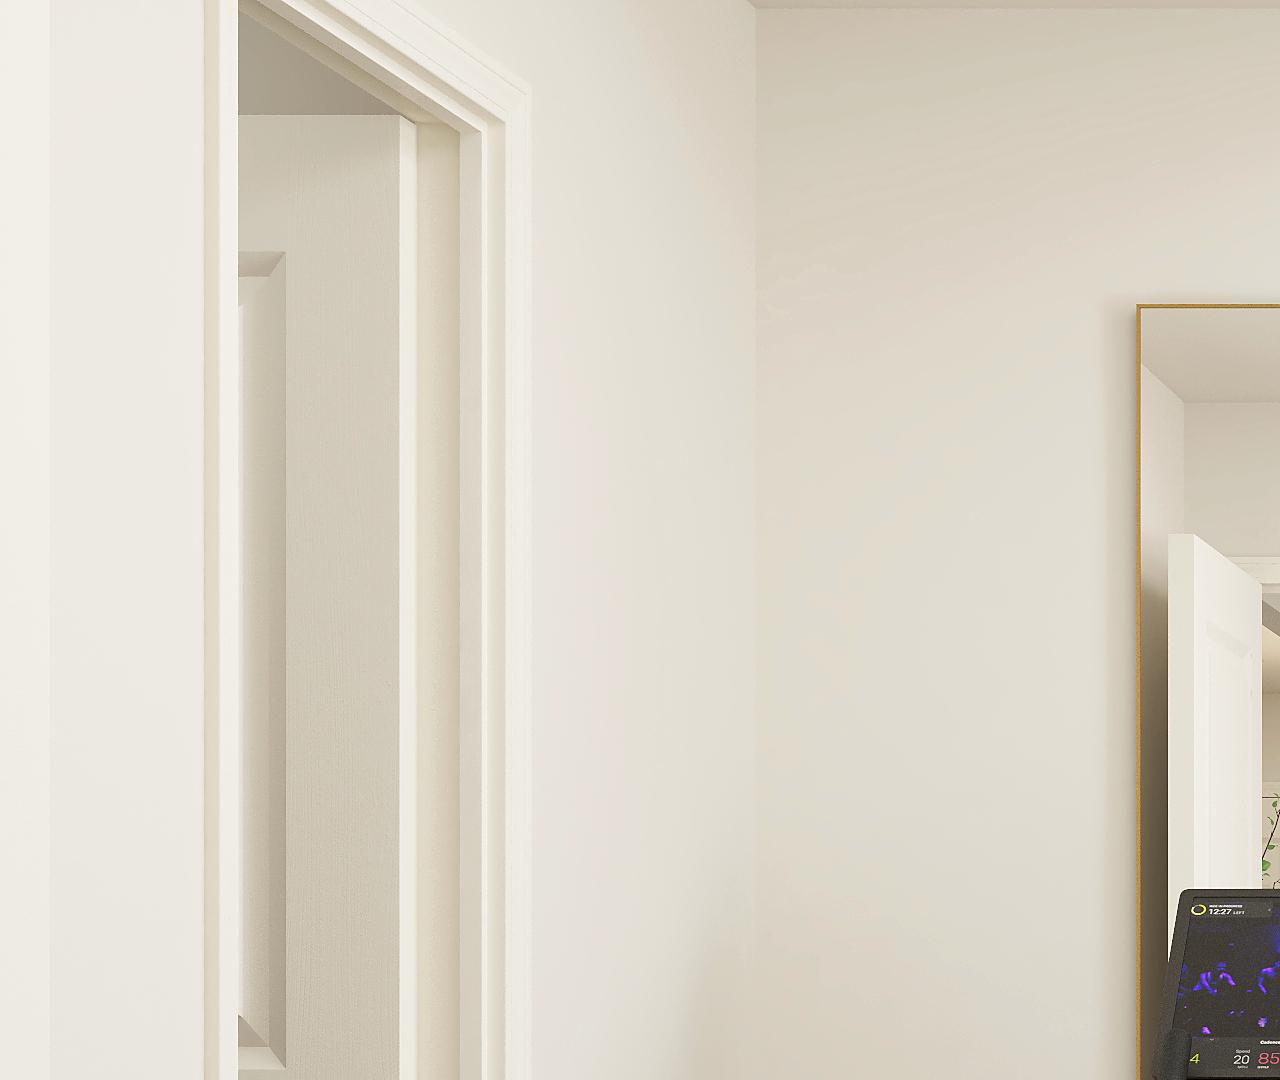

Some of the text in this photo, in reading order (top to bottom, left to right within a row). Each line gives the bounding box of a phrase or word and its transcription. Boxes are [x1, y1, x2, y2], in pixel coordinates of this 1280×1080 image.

[1189, 1053, 1200, 1064] 4
[1233, 1055, 1250, 1064] 20
[1258, 1052, 1280, 1065] 85
